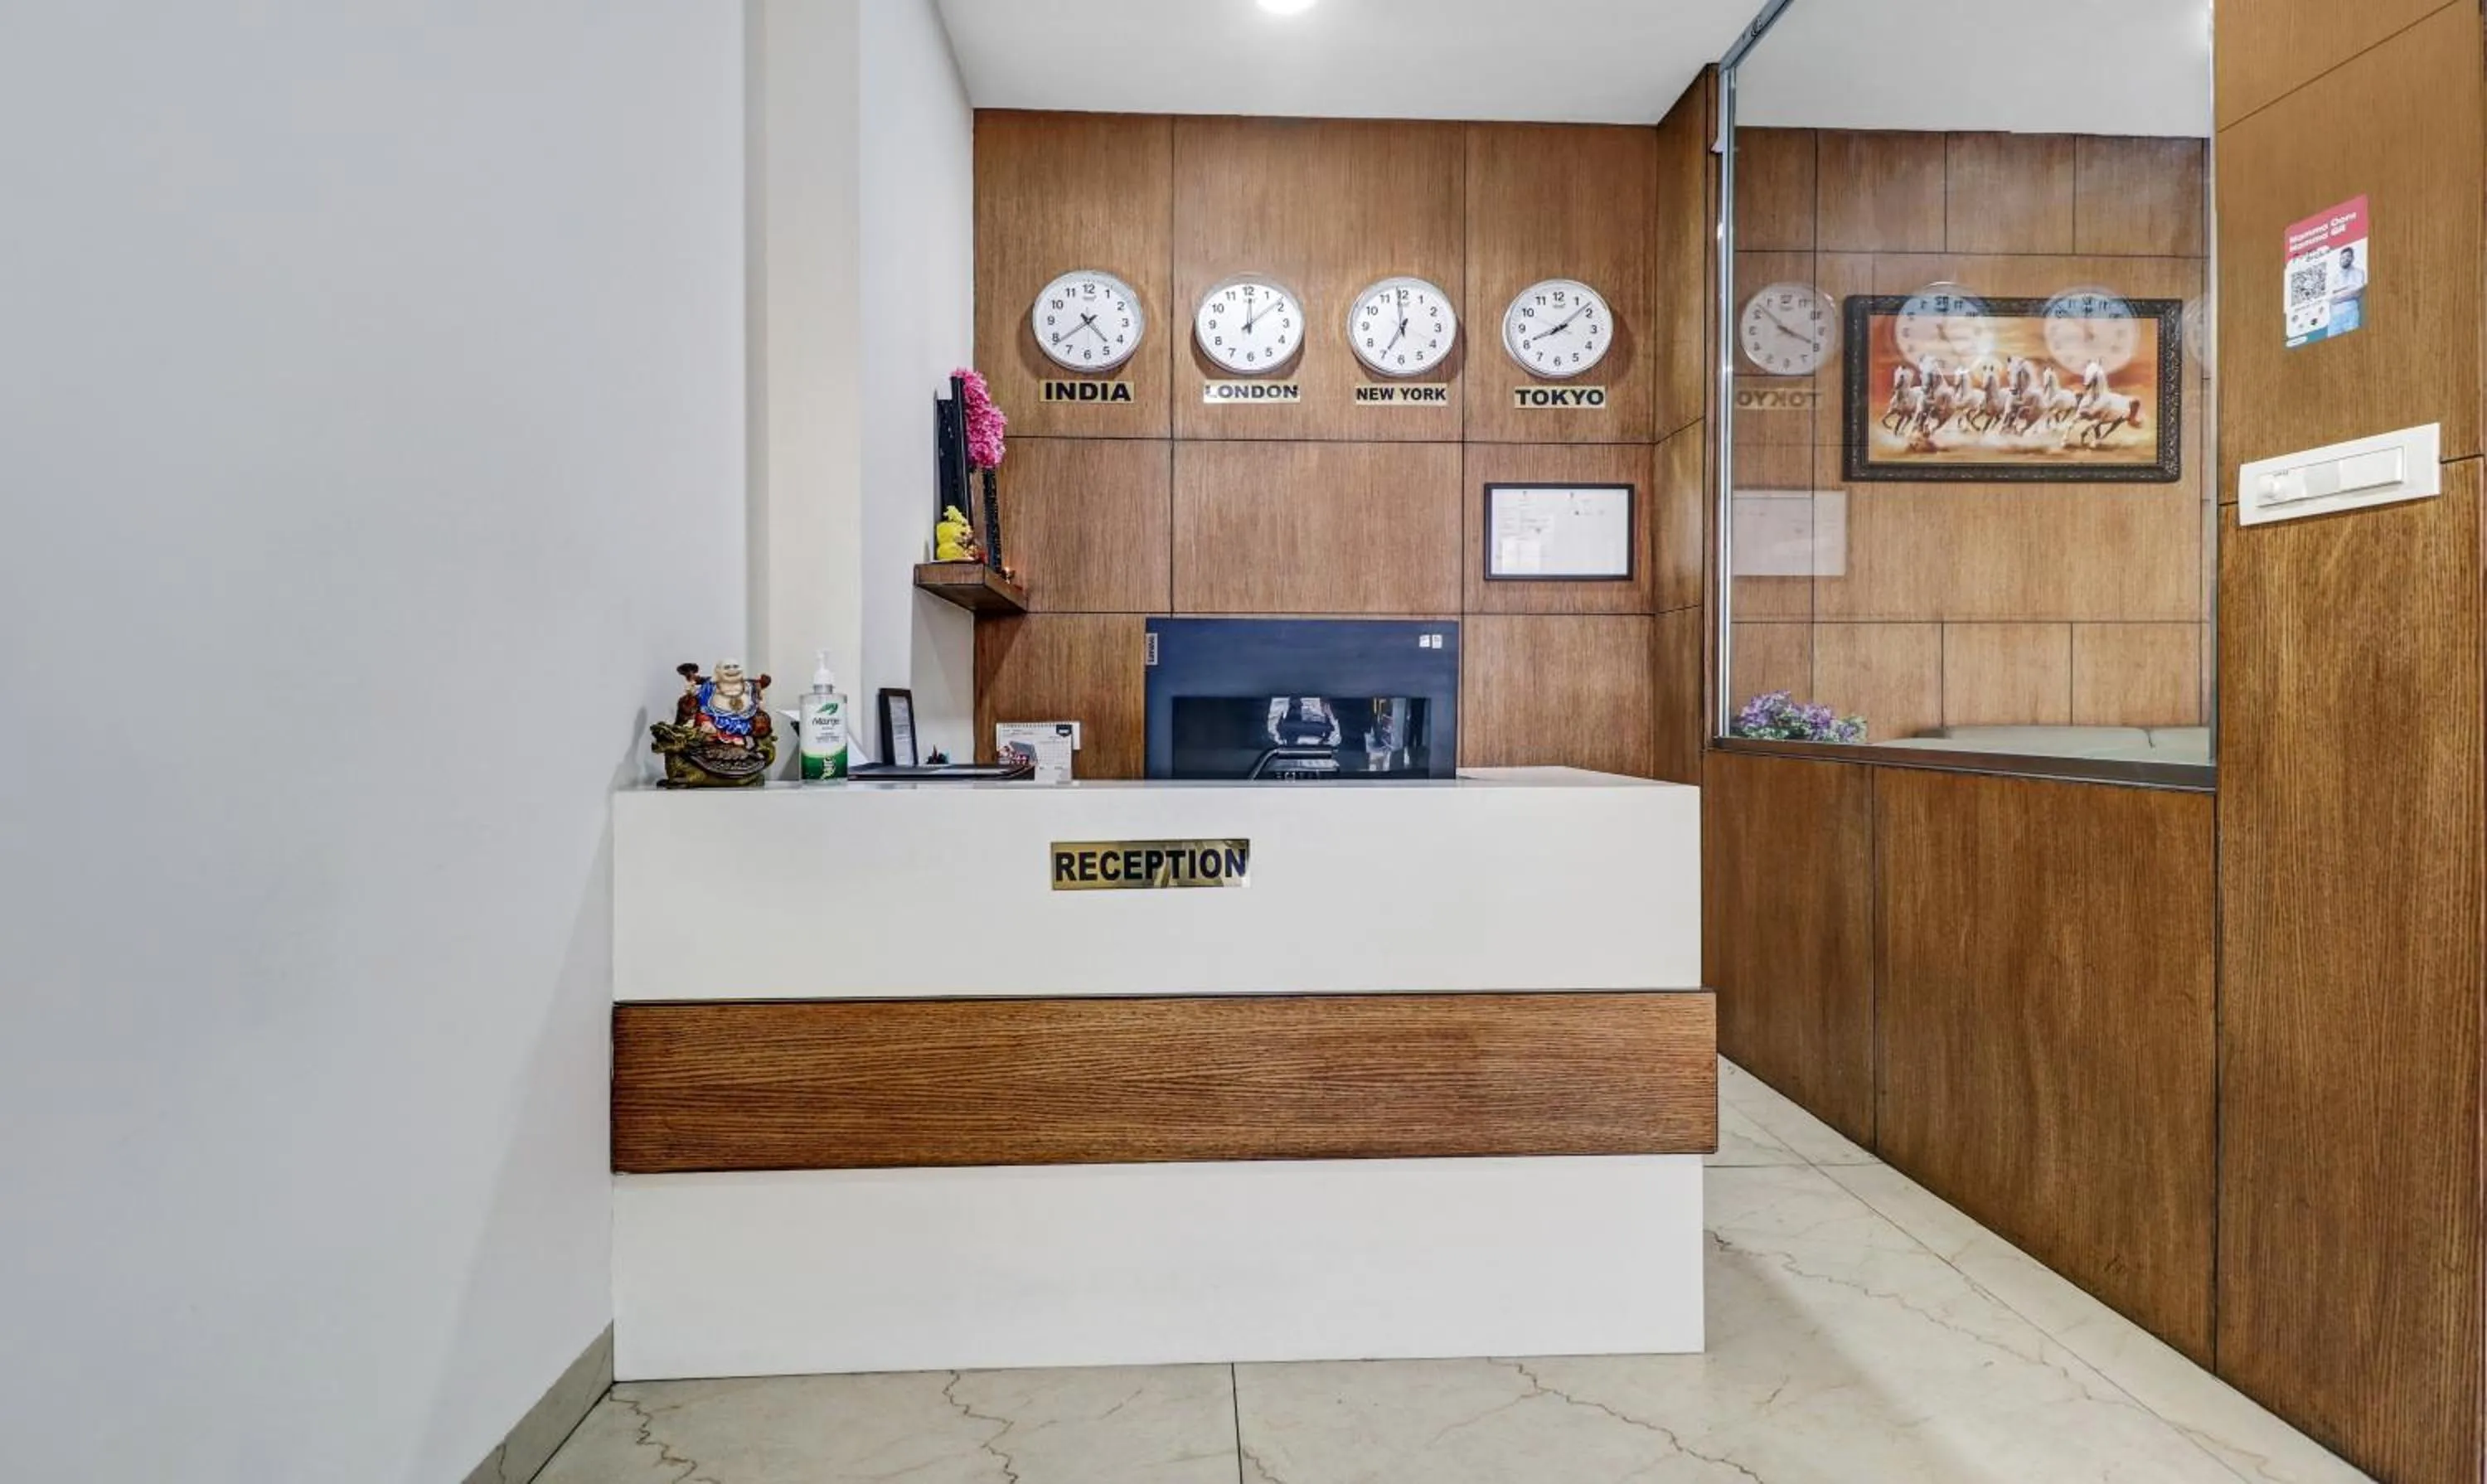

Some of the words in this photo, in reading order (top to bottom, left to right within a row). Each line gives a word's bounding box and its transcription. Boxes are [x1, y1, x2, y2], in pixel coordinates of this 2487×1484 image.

[1066, 288, 1076, 298] 11
[1083, 283, 1095, 294] 12
[1105, 289, 1110, 298] 1
[1243, 286, 1254, 296] 12
[1225, 291, 1236, 301] 11
[1264, 291, 1269, 299] 1
[1379, 293, 1390, 303] 11
[1419, 294, 1423, 304] 1
[1553, 291, 1564, 302] 12
[1051, 299, 1064, 310] 10
[1117, 301, 1125, 311] 2
[1535, 296, 1546, 306] 11
[1574, 296, 1579, 306] 1
[1212, 303, 1224, 313] 10
[1277, 302, 1284, 313] 2
[1366, 306, 1379, 316] 10
[1430, 306, 1438, 317] 2
[1521, 308, 1534, 318] 10
[1585, 308, 1593, 318] 2
[1047, 315, 1055, 325] 9
[1122, 318, 1129, 327] 3
[1208, 319, 1216, 329] 9
[1282, 318, 1290, 328] 3
[1361, 321, 1370, 332] 9
[1434, 323, 1442, 332] 3
[1518, 323, 1526, 333] 9
[1590, 324, 1597, 334] 3
[1117, 334, 1123, 344] 4
[1214, 336, 1223, 346] 8
[1277, 334, 1285, 344] 4
[1366, 337, 1374, 348] 8
[1428, 338, 1437, 348] 4
[1065, 344, 1074, 354] 7
[1523, 339, 1531, 350] 8
[1585, 341, 1593, 350] 4
[1084, 349, 1092, 360] 6
[1103, 346, 1110, 356] 5
[1228, 347, 1236, 358] 7
[1265, 347, 1273, 357] 5
[1379, 349, 1387, 359] 7
[1416, 351, 1423, 361] 5
[1246, 352, 1254, 362] 6
[1397, 355, 1405, 366] 6
[1536, 352, 1543, 361] 7
[1553, 356, 1561, 366] 6
[1572, 352, 1579, 362] 5
[1045, 382, 1132, 401] INDIA
[1205, 385, 1298, 398] LONDON
[1356, 387, 1394, 400] NEW
[1399, 387, 1446, 400] YORK
[1515, 389, 1604, 405] TOKYO
[1055, 849, 1247, 881] RECEPTION
